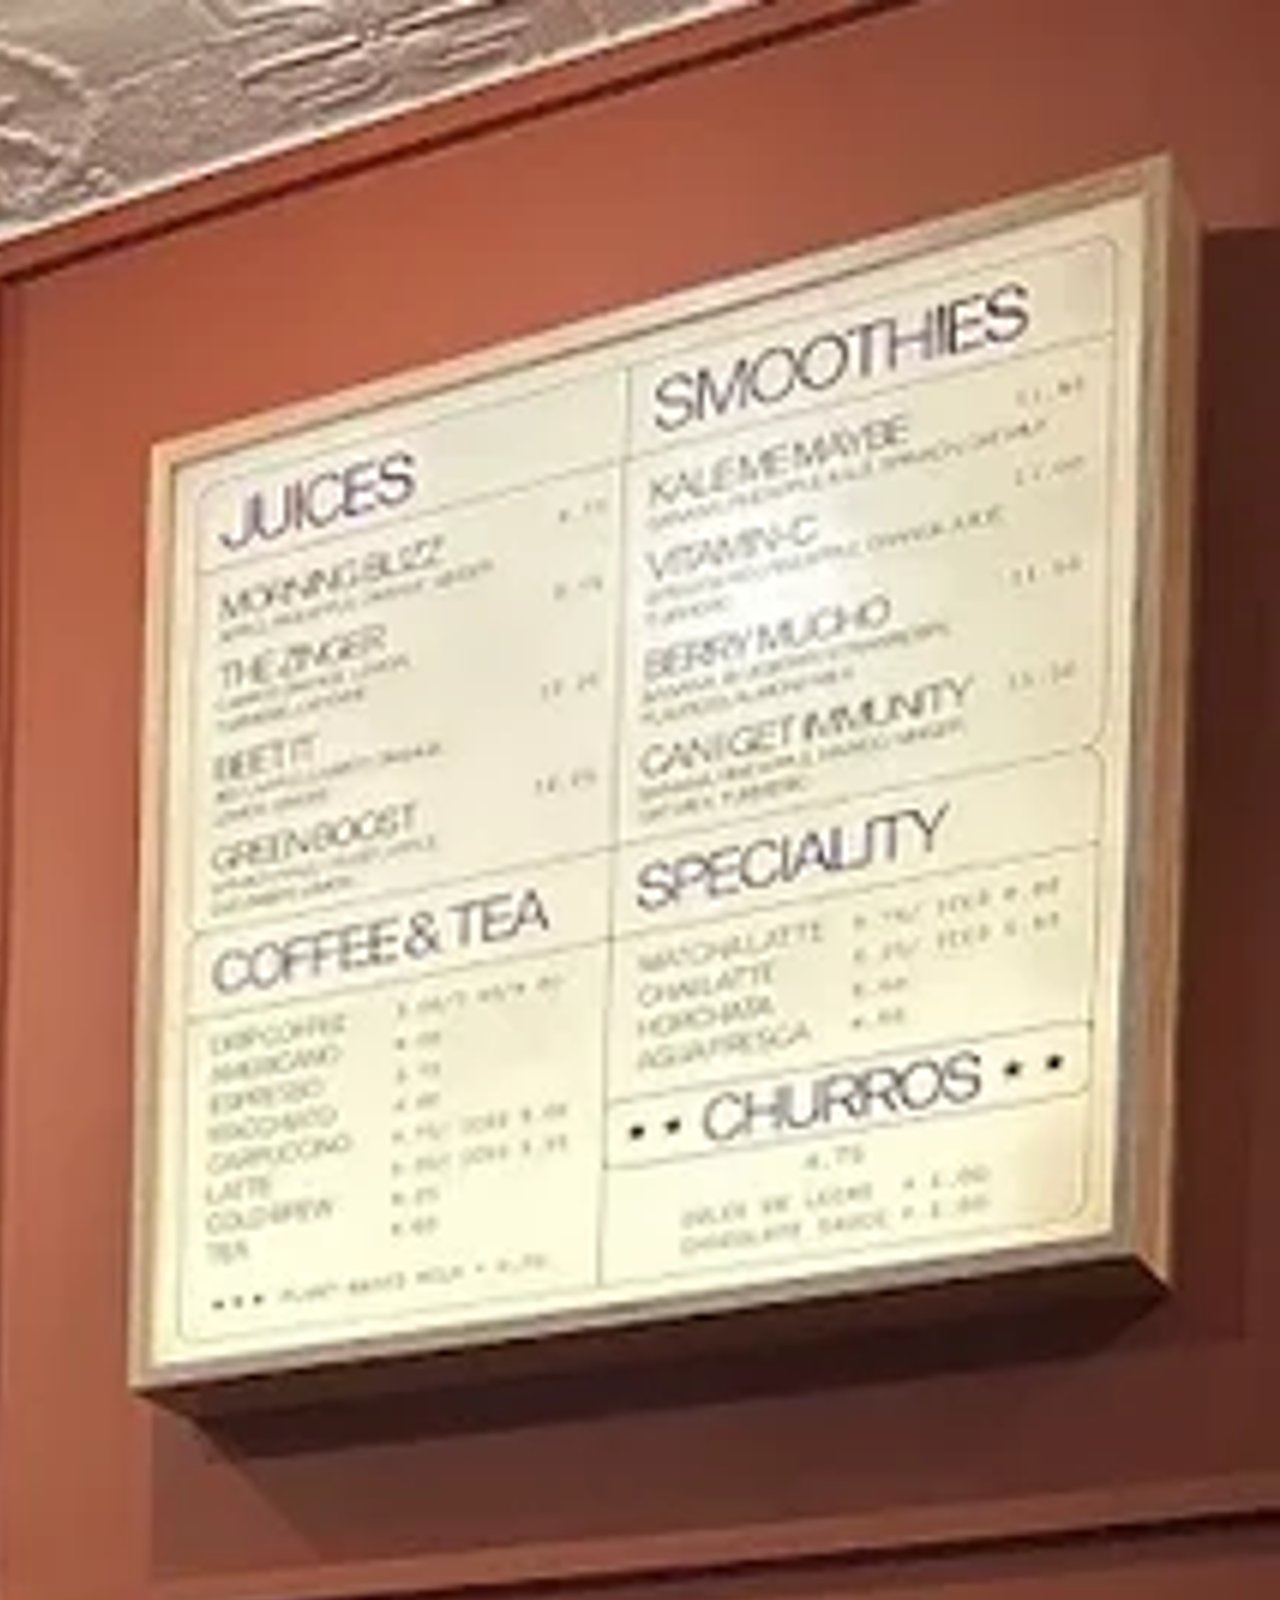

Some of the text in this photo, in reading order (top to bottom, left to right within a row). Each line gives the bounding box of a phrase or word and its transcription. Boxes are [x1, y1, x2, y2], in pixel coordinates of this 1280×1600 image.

[654, 281, 1030, 432] SMOOTHIES
[794, 413, 910, 473] MAYBE
[219, 449, 416, 552] JUICES
[218, 555, 358, 622] MORNING
[758, 592, 892, 656] MUCHO
[636, 803, 950, 912] SPECIALITY
[212, 887, 550, 994] COFFEE & TEA
[702, 1049, 984, 1146] CHURROS
